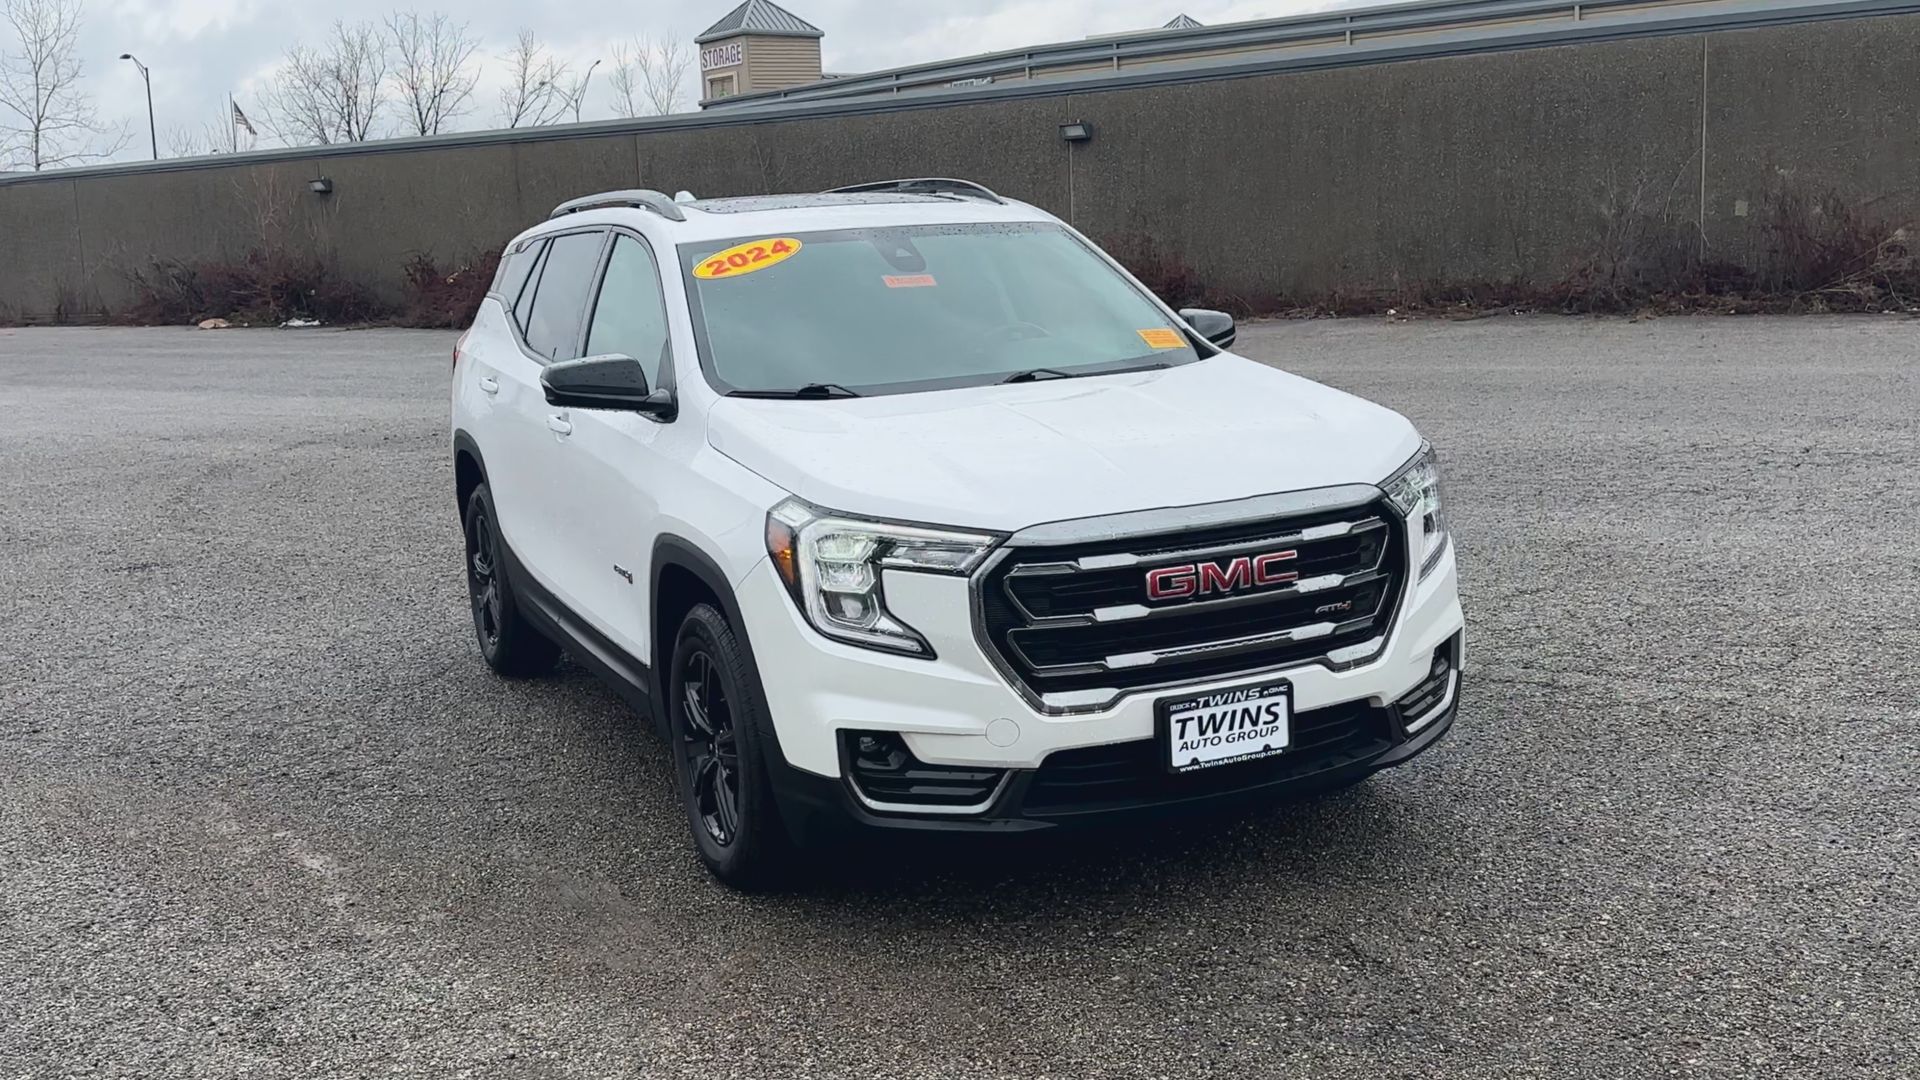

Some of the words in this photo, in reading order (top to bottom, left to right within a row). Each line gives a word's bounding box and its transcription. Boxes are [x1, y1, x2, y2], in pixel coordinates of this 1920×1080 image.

[702, 44, 742, 69] STORAGE
[706, 239, 792, 276] 2024
[1146, 550, 1298, 600] GMC
[1197, 687, 1262, 709] TWINS
[1268, 685, 1288, 694] GMC
[1175, 702, 1280, 741] TWINS
[1178, 735, 1222, 752] AUTO
[1225, 725, 1279, 744] GROUP
[1179, 749, 1283, 772] www.TwinsAutoGroup.com
